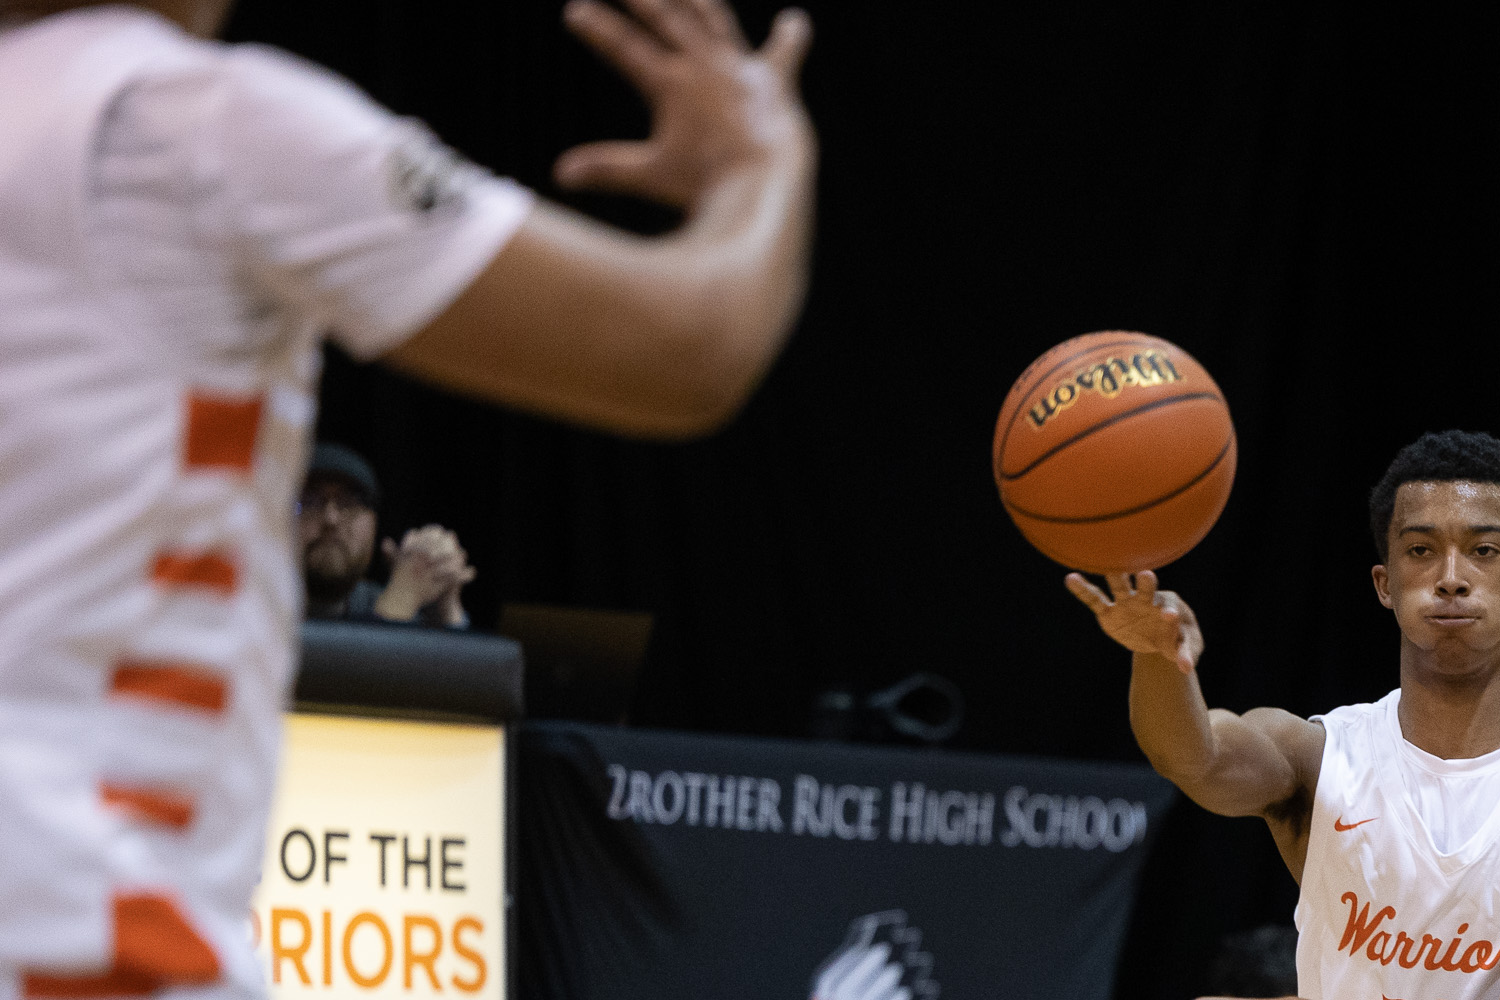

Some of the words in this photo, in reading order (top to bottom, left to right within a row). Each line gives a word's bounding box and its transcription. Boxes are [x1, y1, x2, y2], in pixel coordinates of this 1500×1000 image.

[1028, 350, 1183, 429] Wilson
[792, 774, 881, 841] RICE
[889, 780, 996, 846] HIGH
[281, 828, 350, 883] OF
[370, 834, 467, 891] THE
[250, 907, 489, 994] RIORS
